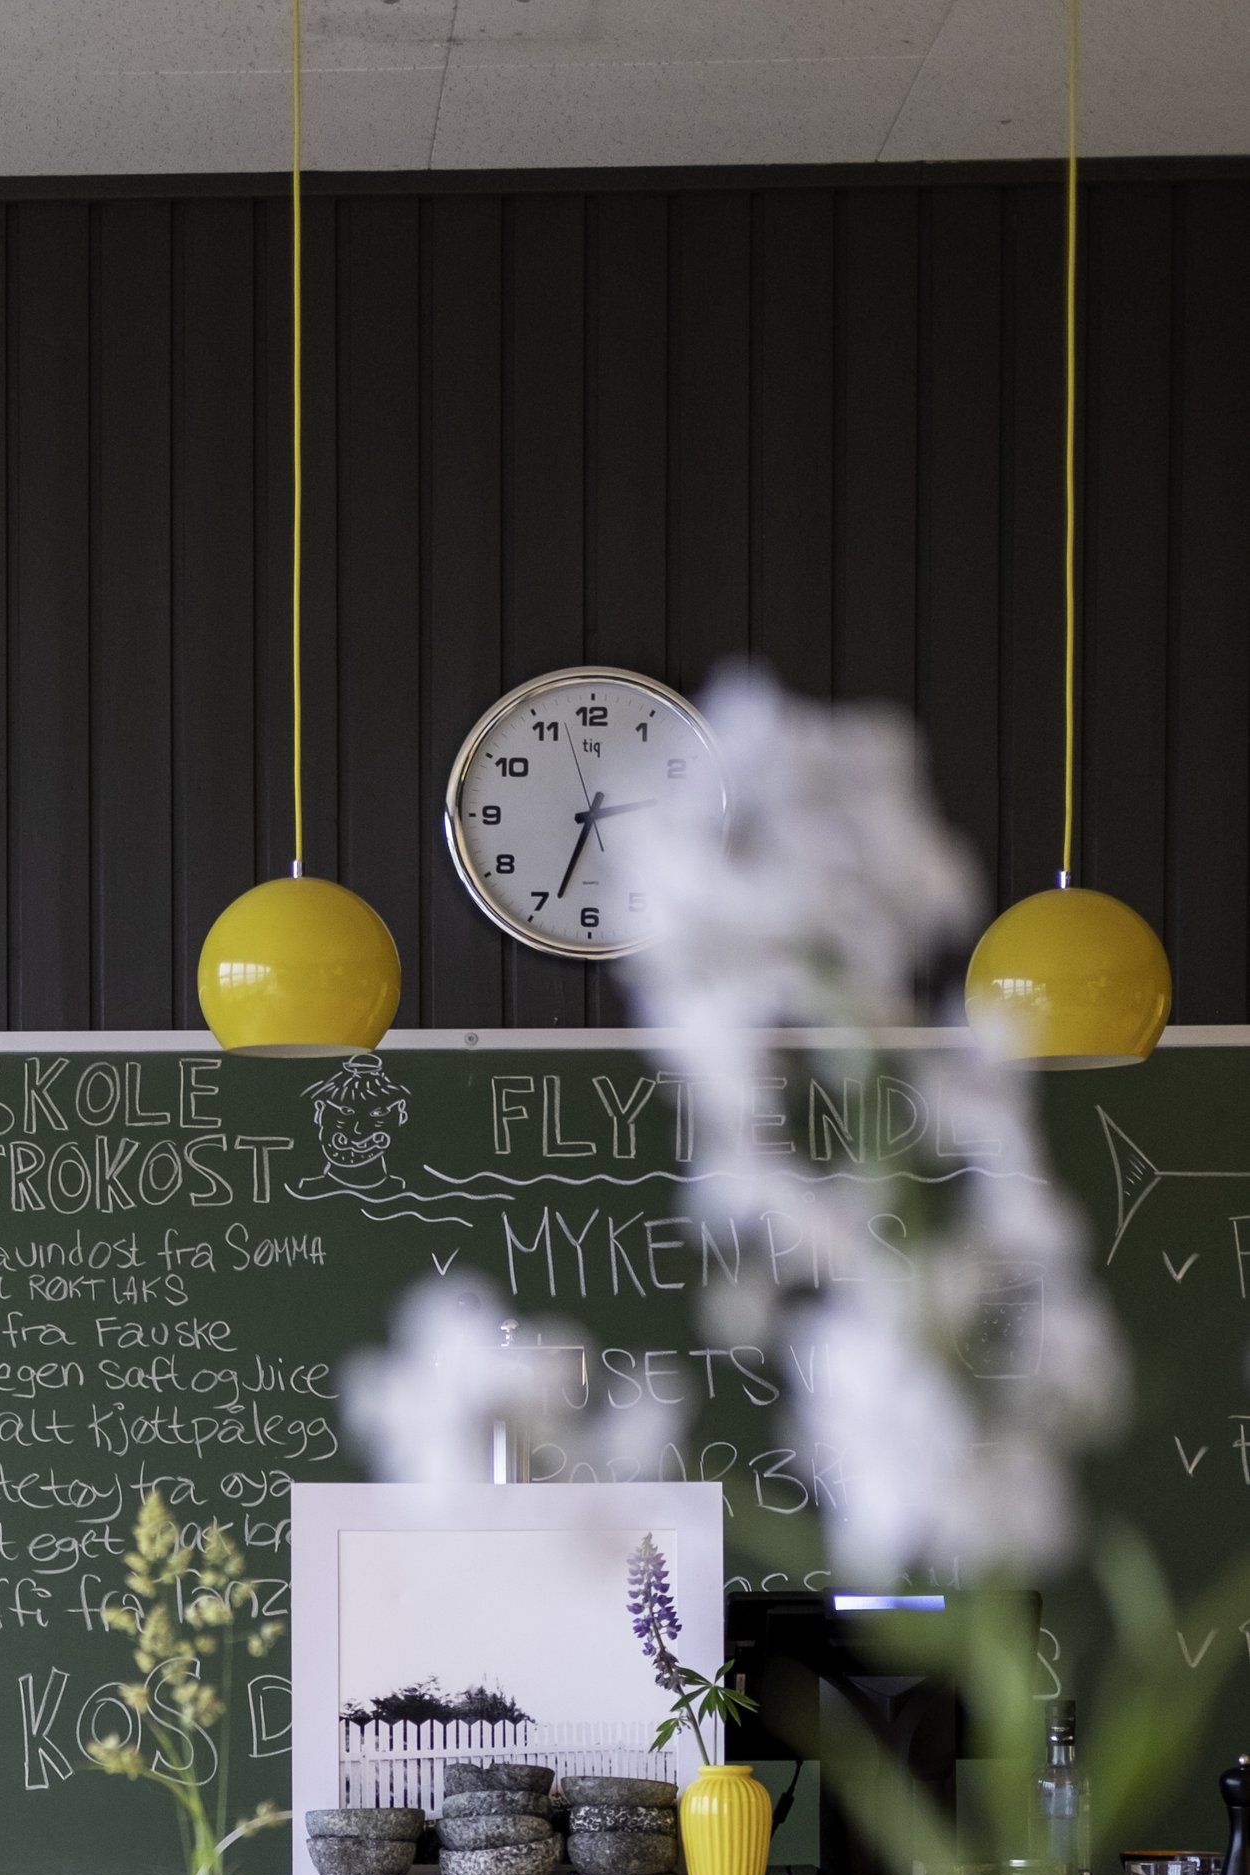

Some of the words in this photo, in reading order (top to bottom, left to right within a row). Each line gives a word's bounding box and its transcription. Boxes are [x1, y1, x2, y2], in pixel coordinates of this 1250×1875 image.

[576, 707, 608, 726] 12
[533, 722, 559, 741] 11
[635, 723, 648, 742] 1
[582, 739, 601, 758] tiq
[495, 757, 529, 777] 10
[667, 759, 687, 779] 2
[482, 805, 501, 825] 9
[496, 854, 515, 874] 8
[531, 891, 549, 911] 7
[580, 907, 599, 927] 6
[158, 1228, 217, 1273] fra
[501, 1206, 742, 1299] MYKEN
[2, 1311, 78, 1349] fra
[95, 1316, 239, 1352] Fauske
[191, 1368, 240, 1410] og
[26, 1523, 126, 1575] eget
[18, 1658, 218, 1790] KOS
